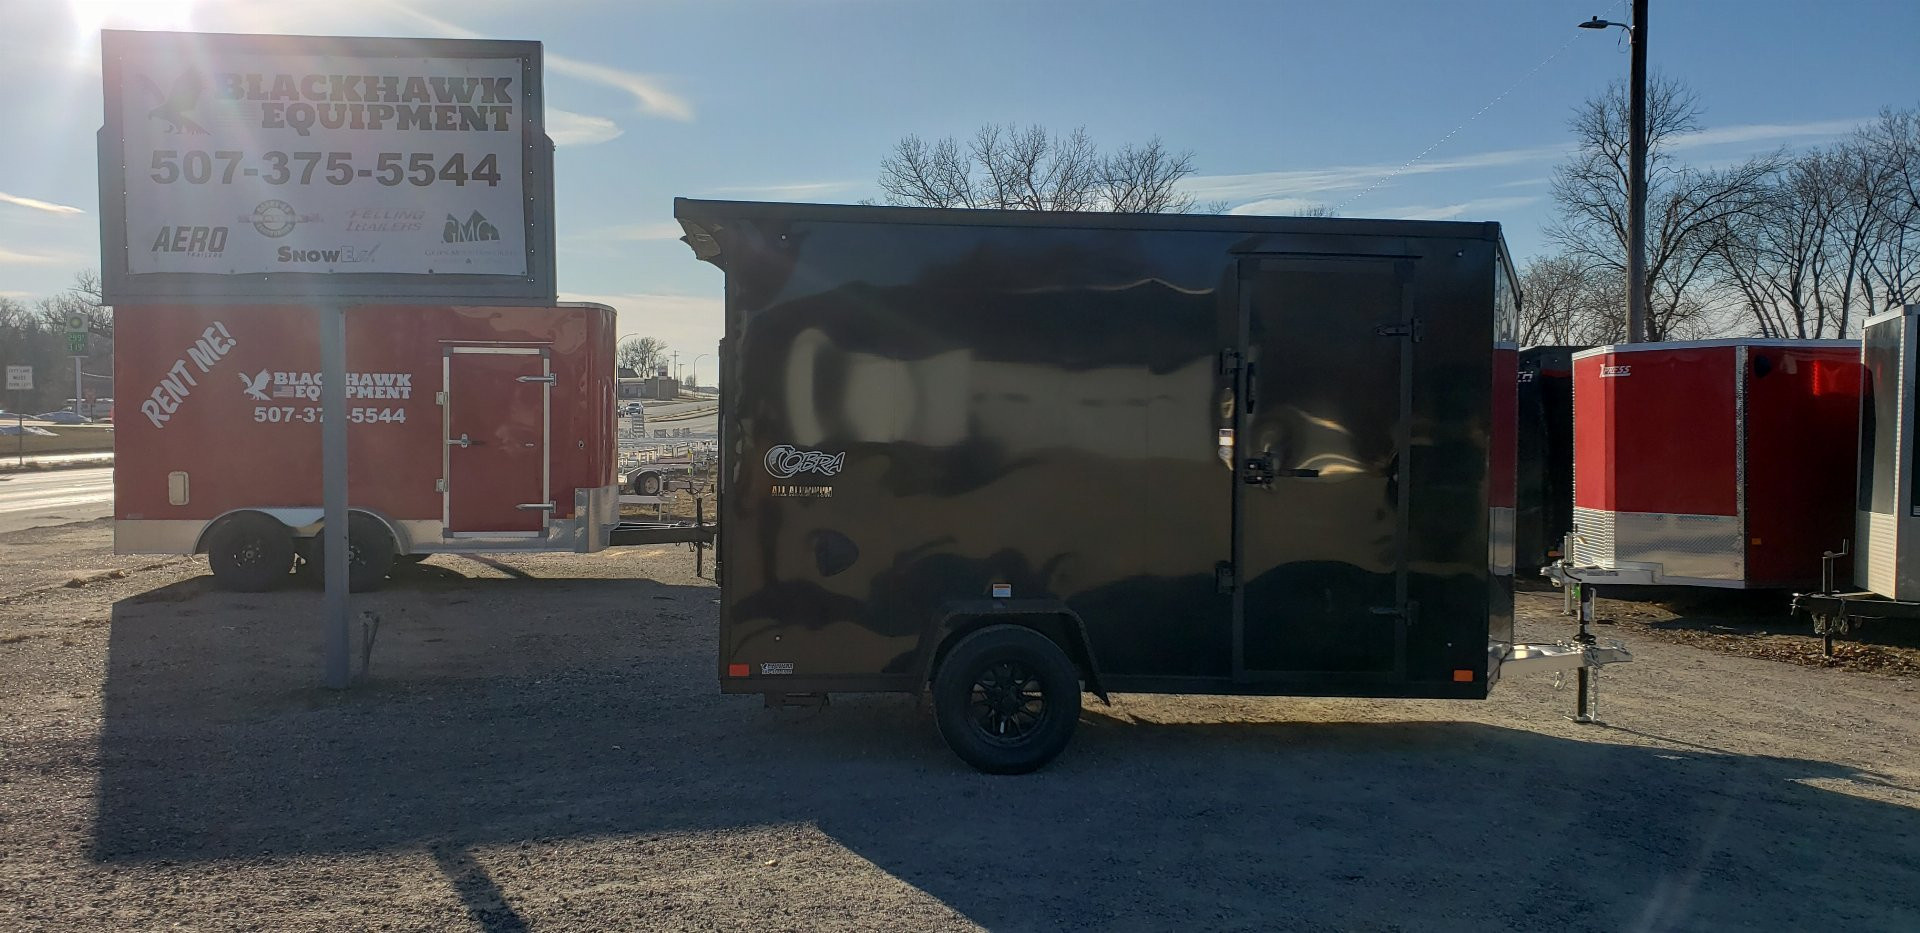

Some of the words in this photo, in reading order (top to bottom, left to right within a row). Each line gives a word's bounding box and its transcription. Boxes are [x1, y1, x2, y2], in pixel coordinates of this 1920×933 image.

[215, 72, 513, 104] BLACKHAWK
[261, 103, 513, 136] EQUIPMENT
[150, 150, 501, 187] 507-375-5544
[151, 226, 229, 253] AERO
[141, 359, 197, 429] RENT
[187, 321, 237, 373] ME!
[273, 372, 412, 386] BLACHAWK
[295, 385, 412, 401] EQPMENT
[254, 406, 406, 424] 507-37-5544
[764, 444, 846, 479] COBRA
[772, 485, 787, 497] ALL
